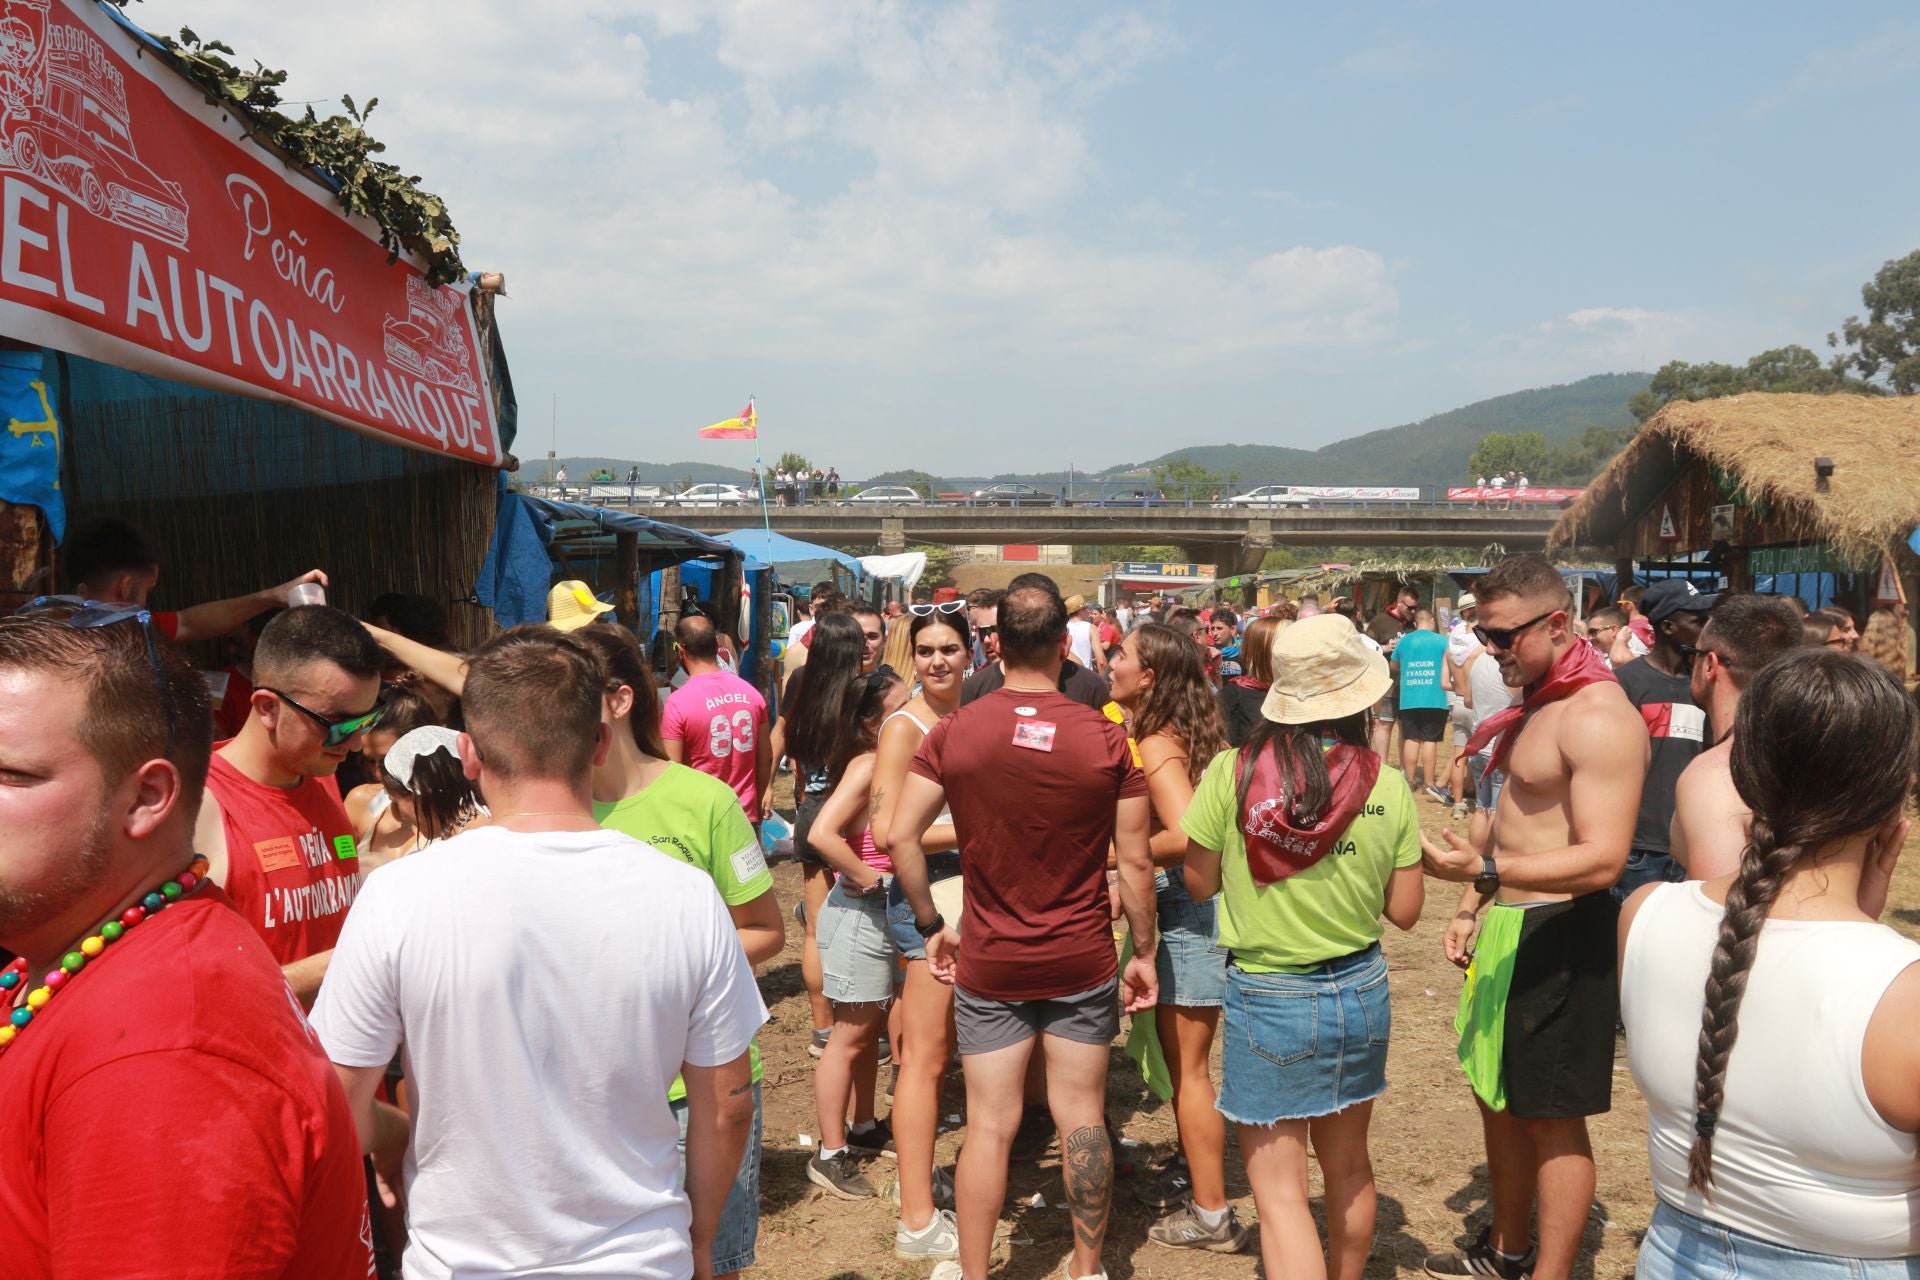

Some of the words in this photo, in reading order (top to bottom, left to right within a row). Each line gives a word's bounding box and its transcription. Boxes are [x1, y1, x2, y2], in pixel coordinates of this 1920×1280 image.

[225, 173, 345, 314] Peña
[1, 175, 106, 316] EL
[125, 240, 488, 456] AUTOARRANQUE
[1161, 564, 1190, 576] PITI
[710, 709, 753, 758] 83
[651, 835, 670, 844] San
[671, 837, 694, 863] Roque
